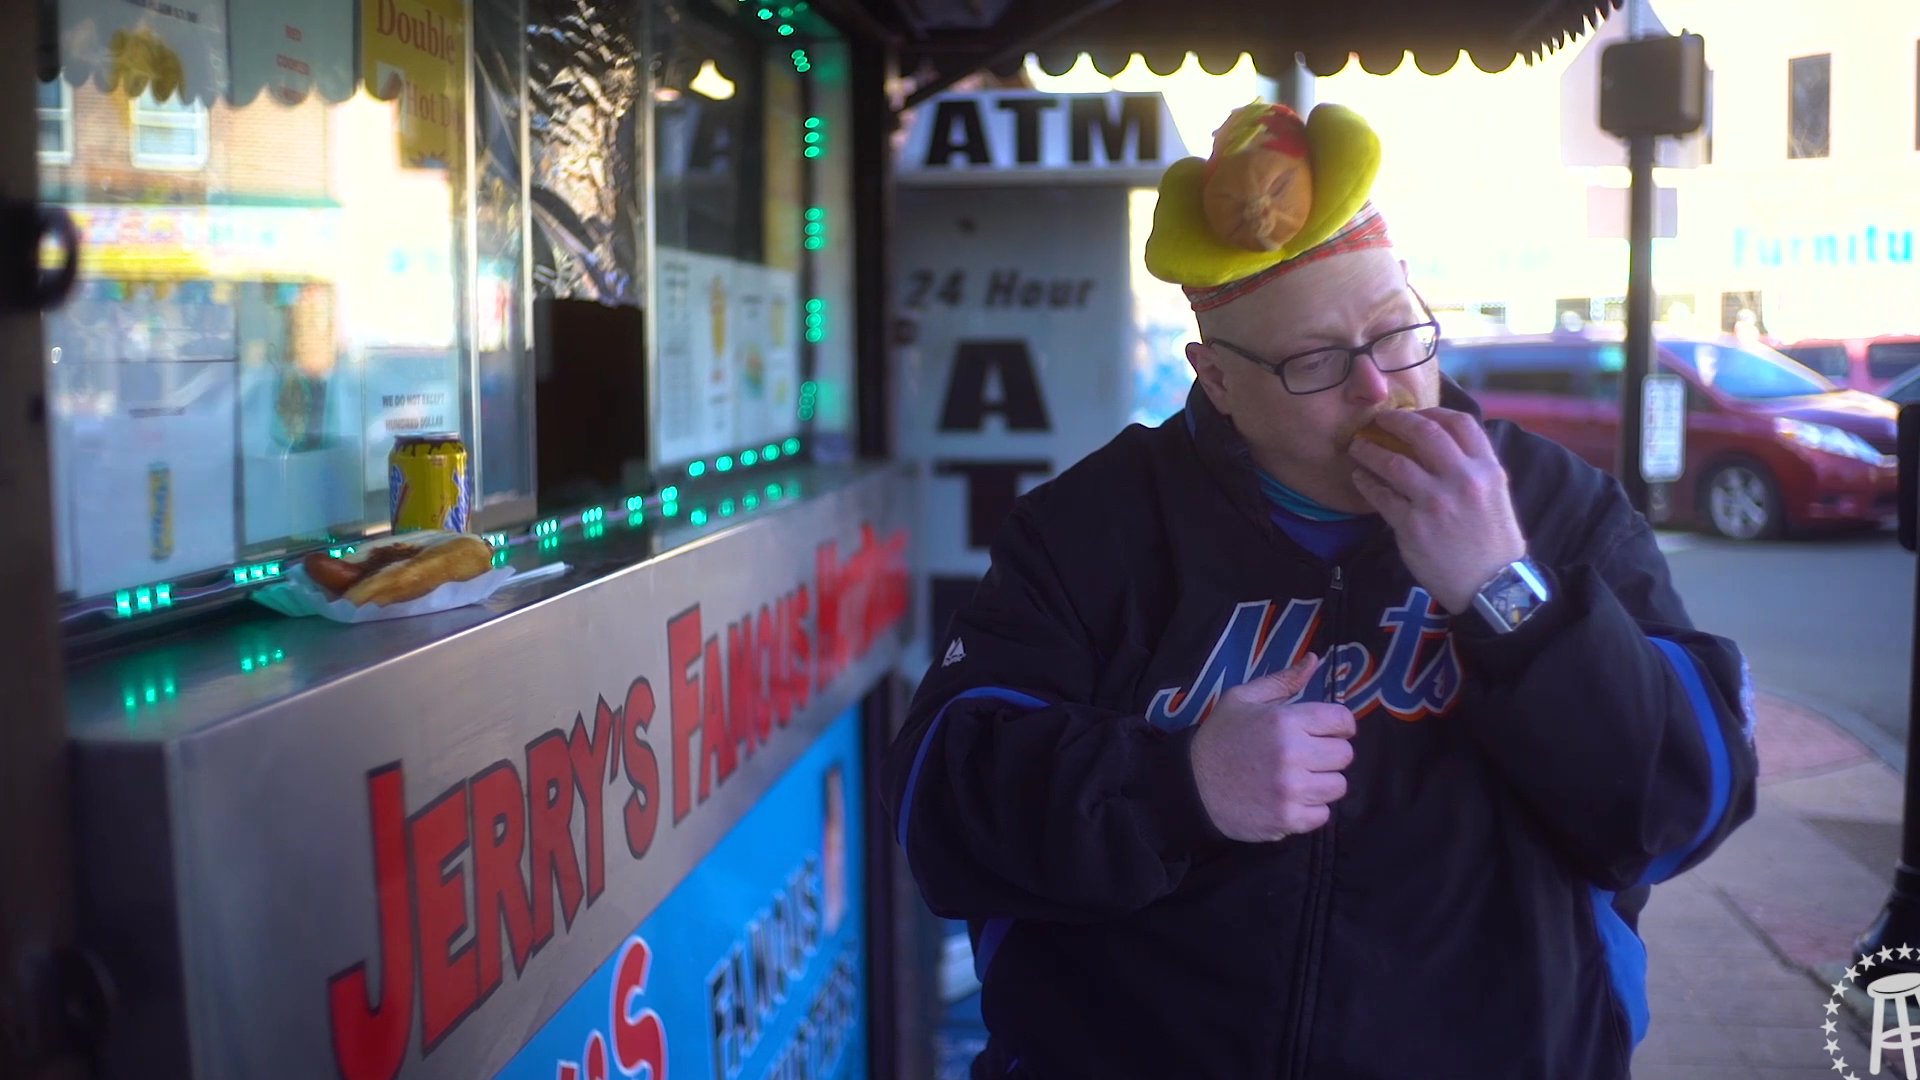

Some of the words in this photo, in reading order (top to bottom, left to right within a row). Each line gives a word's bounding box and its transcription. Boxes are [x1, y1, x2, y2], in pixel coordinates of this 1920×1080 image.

[376, 0, 455, 66] Double
[924, 97, 1161, 166] ATM
[908, 270, 966, 308] 24
[984, 269, 1096, 309] Hour
[382, 394, 394, 408] WE
[394, 393, 406, 407] DO
[406, 393, 421, 406] NOT
[1144, 584, 1466, 734] Mets
[327, 674, 659, 1080] JERRY'S
[666, 584, 812, 827] FAMOUS
